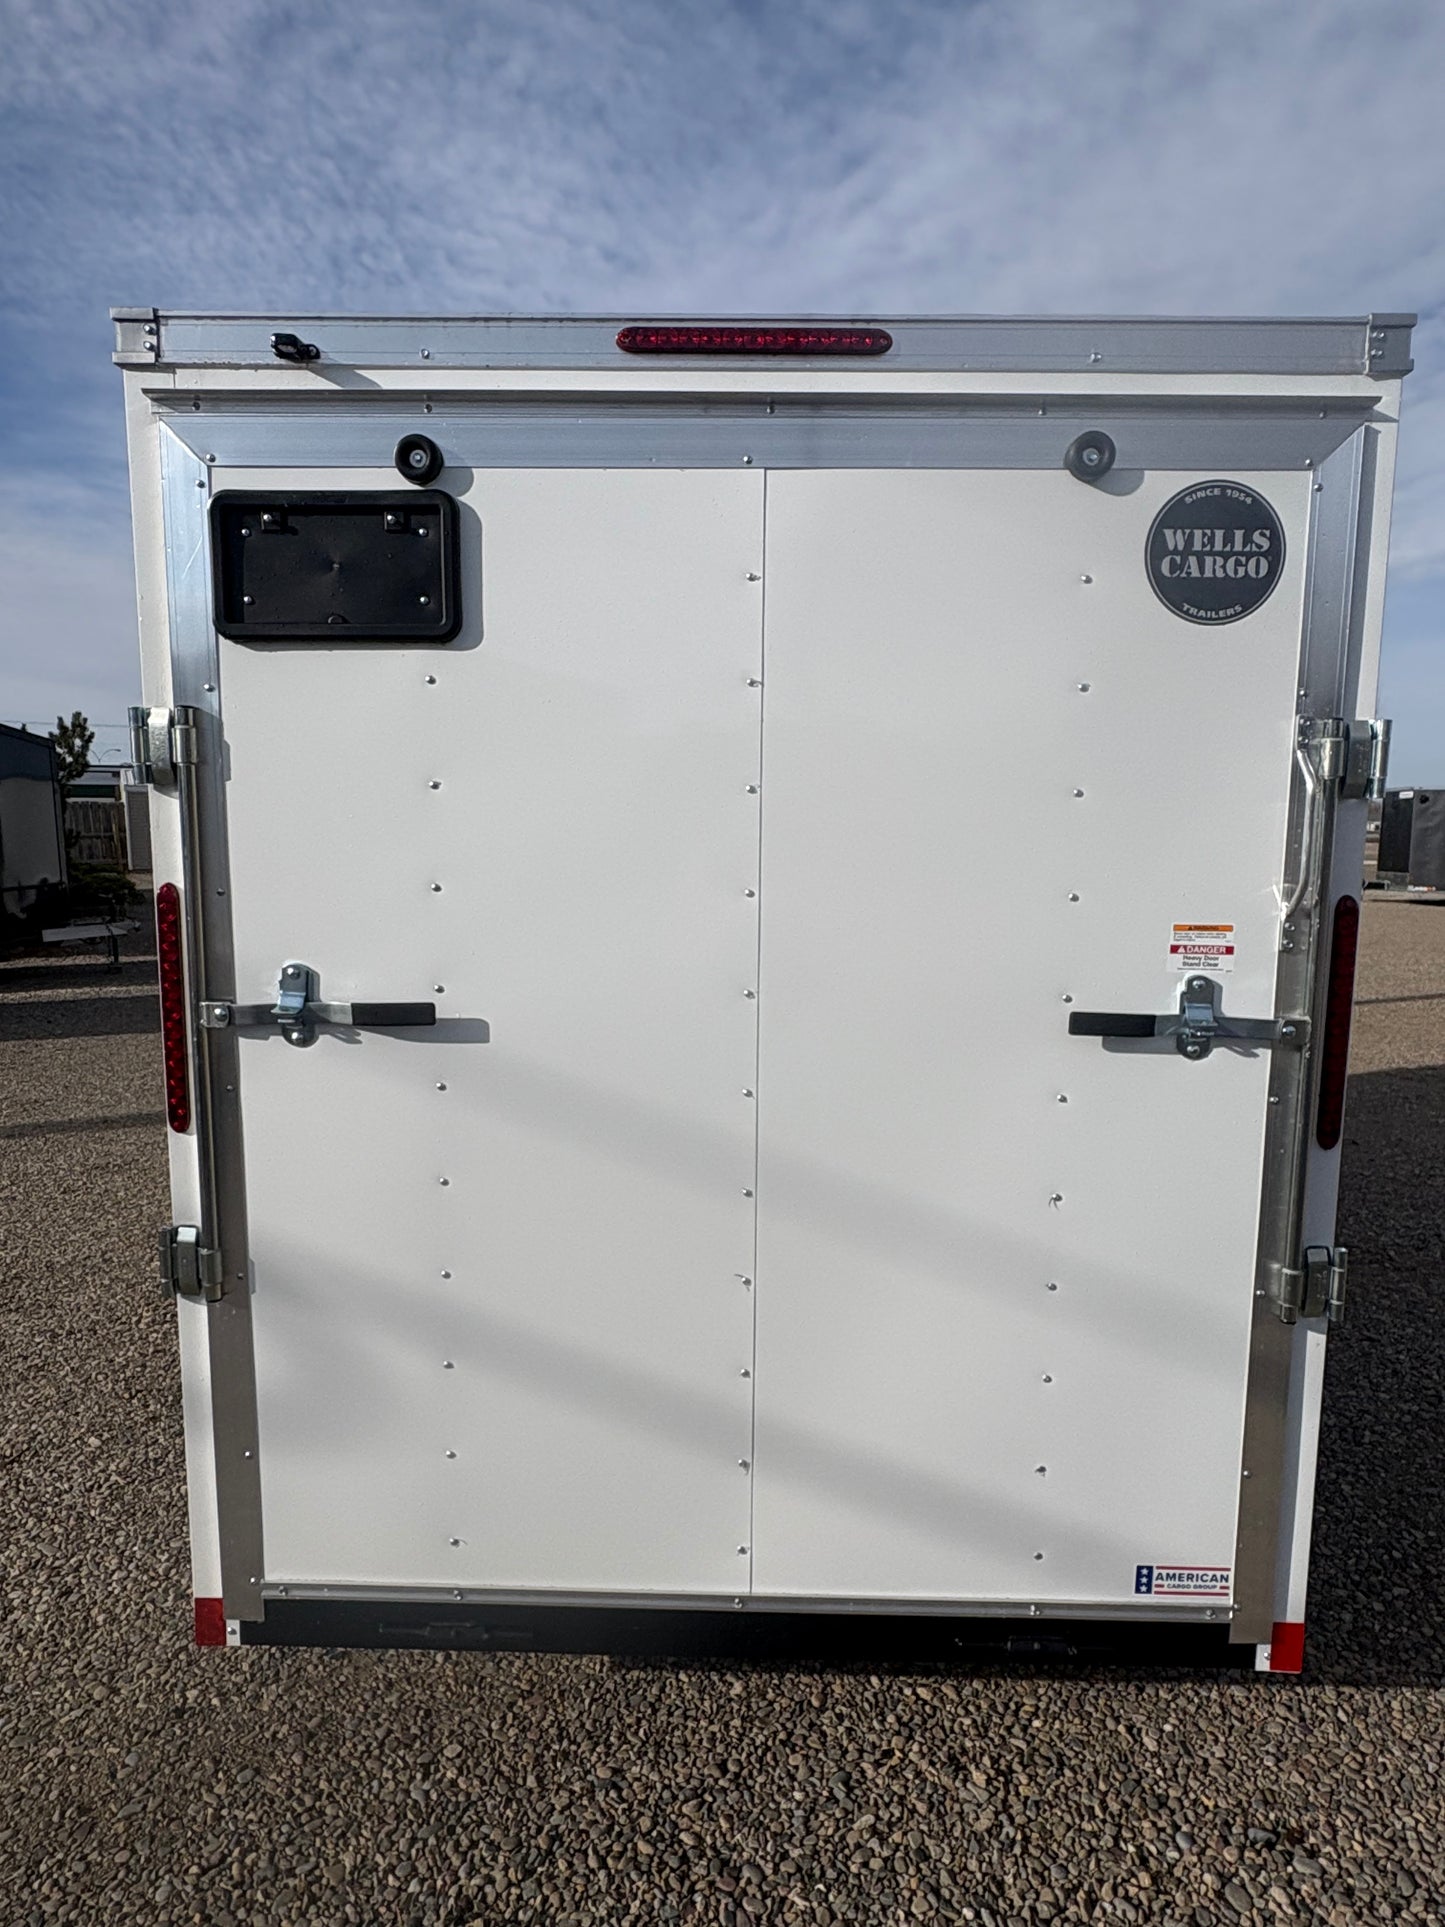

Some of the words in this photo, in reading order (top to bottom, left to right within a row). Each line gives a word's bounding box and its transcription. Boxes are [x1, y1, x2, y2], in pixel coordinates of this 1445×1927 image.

[1184, 488, 1221, 504] SINCE
[1225, 489, 1253, 505] 1954
[1162, 528, 1271, 552] WELLS
[1160, 554, 1269, 579] CARGO
[1181, 602, 1243, 618] TRAILERS
[1186, 946, 1226, 954] DANGER
[1155, 1572, 1229, 1583] AMERICAN
